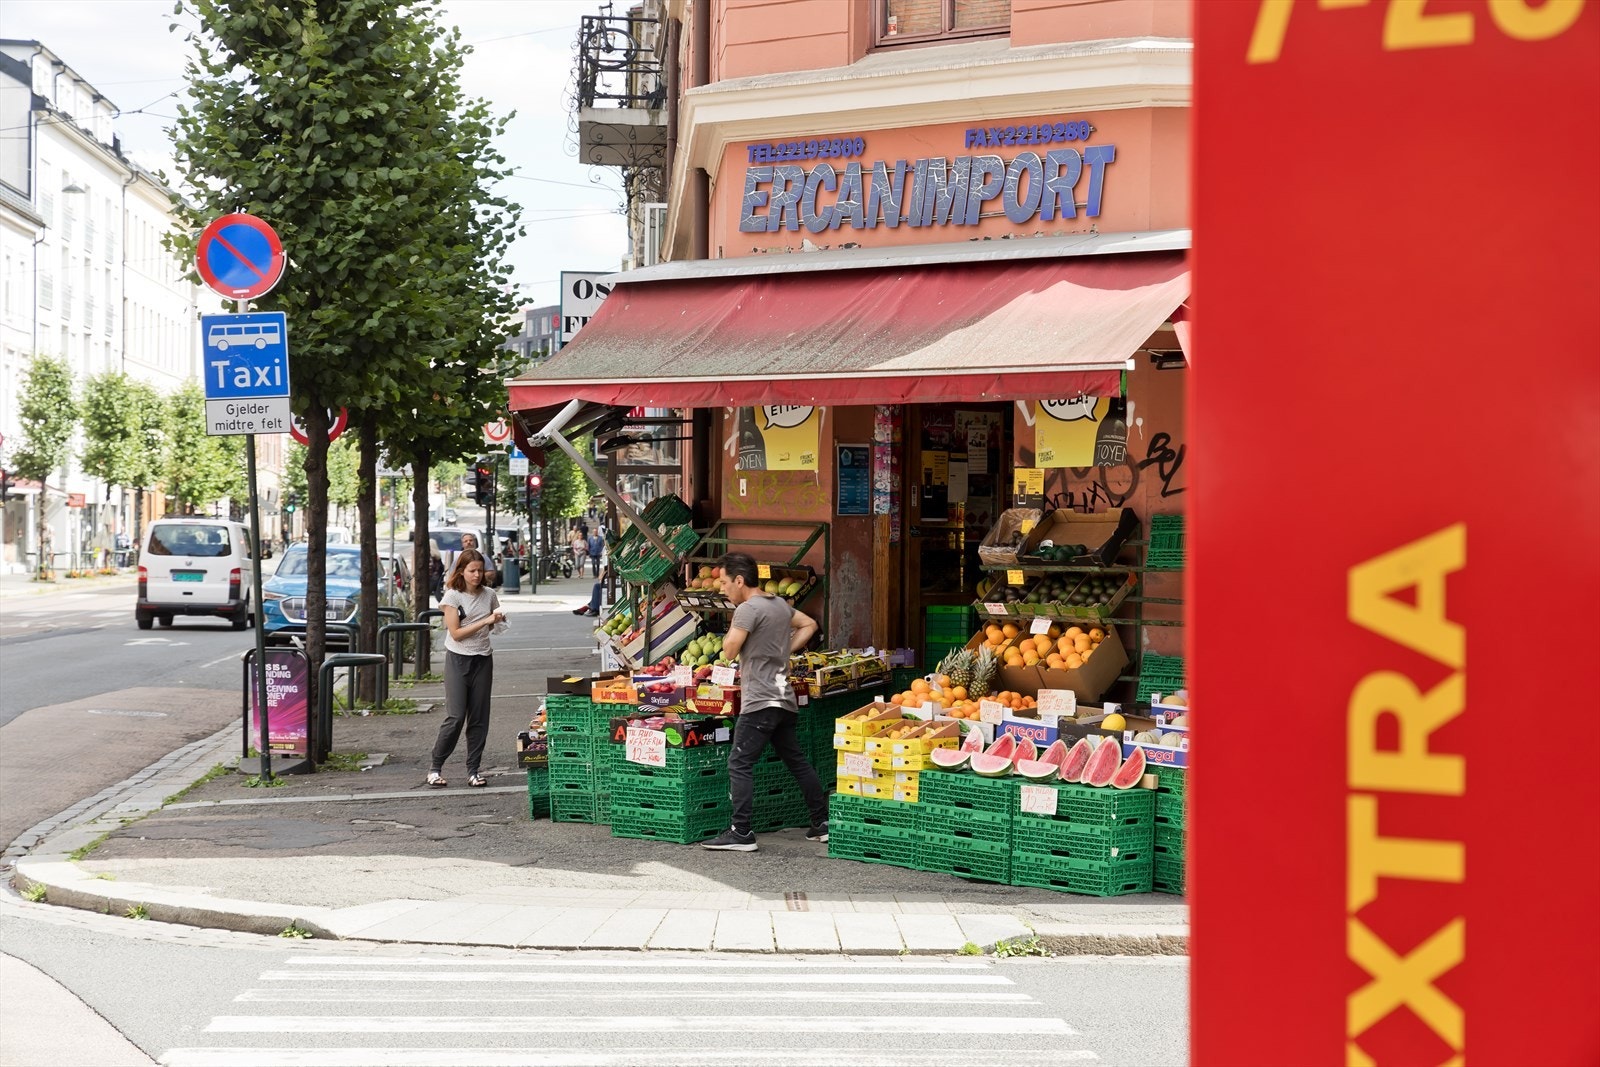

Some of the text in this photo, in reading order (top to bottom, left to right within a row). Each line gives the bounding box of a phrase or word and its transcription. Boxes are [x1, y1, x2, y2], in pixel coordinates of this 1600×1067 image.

[739, 144, 1115, 233] ERCAN IMPORT
[211, 358, 281, 388] Taxi
[226, 403, 269, 417] Gjelder
[215, 418, 282, 431] midtre felt
[257, 685, 298, 693] CEIVING
[1144, 748, 1176, 763] regal
[1347, 521, 1466, 1067] XTRA
